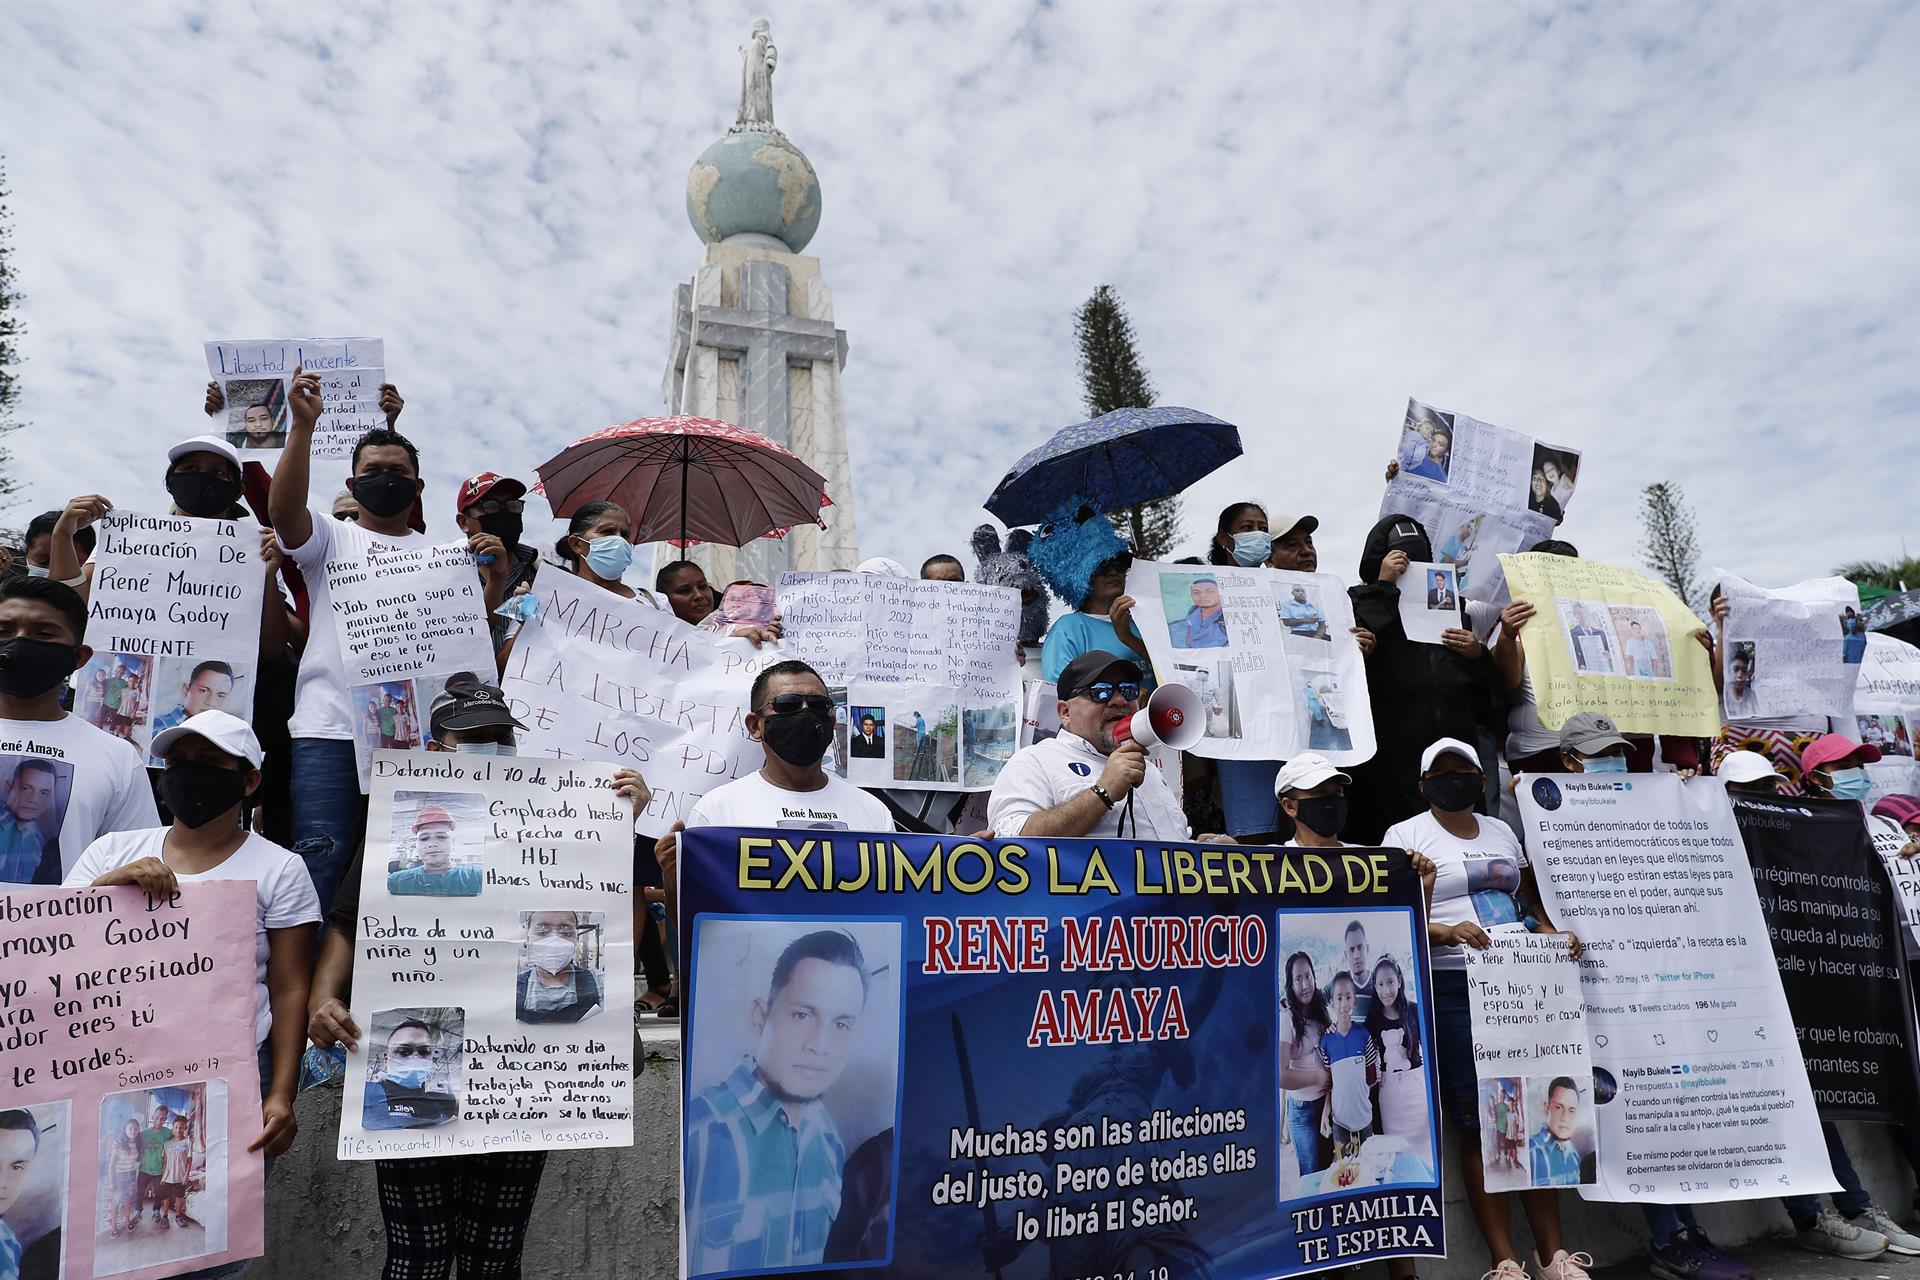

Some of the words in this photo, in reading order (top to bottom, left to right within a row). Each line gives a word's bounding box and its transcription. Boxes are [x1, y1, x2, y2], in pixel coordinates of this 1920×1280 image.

[218, 346, 284, 376] Libertad
[102, 509, 192, 533] Suplicamos
[217, 522, 235, 537] La
[105, 535, 197, 560] Liberación
[220, 545, 247, 564] De
[326, 562, 358, 575] Rene
[367, 552, 423, 567] Mauricio
[100, 567, 152, 592] René
[167, 570, 242, 599] Mauricio
[780, 573, 828, 586] Libertad
[833, 576, 858, 591] para
[887, 581, 939, 594] capturado
[377, 593, 416, 608] nunca
[425, 588, 454, 601] supo
[463, 585, 473, 596] el
[90, 601, 156, 624] Amaya
[169, 602, 229, 630] Godoy
[346, 614, 388, 630] motivo
[395, 608, 408, 620] de
[417, 608, 431, 617] su
[782, 606, 822, 624] Antonio
[825, 610, 863, 623] Navidad
[888, 611, 913, 624] 2022
[962, 616, 991, 632] propia
[350, 642, 368, 654] que
[374, 635, 399, 646] Dios
[406, 633, 416, 641] lo
[422, 627, 459, 639] amaba
[540, 590, 691, 671] MARCHA
[866, 624, 888, 640] hijo
[894, 630, 905, 638] es
[908, 632, 928, 640] una
[110, 637, 194, 656] INOCENTE
[509, 647, 565, 692] LA
[948, 655, 963, 667] No
[971, 660, 993, 669] mas
[949, 671, 995, 685] Regimen
[26, 741, 64, 758] Amaya
[586, 722, 650, 761] LOS
[1566, 783, 1586, 791] Nayib
[1588, 783, 1612, 791] Bukele
[588, 802, 623, 821] hasta
[1570, 798, 1616, 806] @nayibbukele
[782, 808, 805, 819] René
[808, 809, 838, 820] Amaya
[1540, 821, 1550, 832] El
[1553, 820, 1585, 831] común
[1588, 820, 1650, 831] denominador
[1654, 820, 1665, 830] de
[1668, 820, 1692, 830] todos
[1694, 820, 1708, 830] los
[738, 837, 1030, 893] EXIJIMOS
[1047, 847, 1119, 894] LA
[1135, 849, 1333, 894] LIBERTAD
[1342, 855, 1389, 893] DE
[540, 870, 593, 891] brands
[1766, 866, 1818, 886] régimen
[1821, 875, 1870, 891] controla
[1556, 888, 1611, 900] mantenerse
[1614, 889, 1625, 898] en
[1628, 887, 1637, 898] el
[1640, 887, 1670, 900] poder,
[1674, 887, 1705, 899] aunque
[1707, 887, 1722, 896] sus
[1801, 901, 1858, 919] manipula
[460, 926, 494, 939] una
[1781, 927, 1822, 945] queda
[1827, 929, 1837, 944] al
[1840, 932, 1883, 950] pueblo?
[922, 917, 1049, 975] RENE
[1061, 914, 1267, 972] MAURICIO
[424, 946, 436, 965] y
[454, 948, 480, 959] un
[49, 974, 61, 997] y
[76, 953, 213, 990] necesitado
[1654, 973, 1680, 983] Twitter
[1682, 973, 1692, 981] for
[1693, 971, 1715, 980] iPhone
[1508, 978, 1534, 997] hijos
[1541, 986, 1547, 998] y
[1554, 984, 1564, 995] tu
[54, 1000, 82, 1017] en
[93, 991, 121, 1009] mi
[1483, 1000, 1524, 1013] esposa
[1535, 999, 1544, 1010] te
[1638, 1003, 1662, 1012] Tweets
[1663, 1002, 1690, 1012] citados
[1695, 1000, 1708, 1009] 196
[69, 1015, 115, 1038] eres
[131, 1004, 154, 1027] tú
[1027, 986, 1189, 1046] AMAYA
[1486, 1011, 1539, 1026] esperamos
[1546, 1013, 1556, 1022] en
[1474, 1043, 1501, 1062] Porque
[1508, 1046, 1528, 1058] eres
[1534, 1043, 1582, 1058] INOCENTE
[12, 1067, 35, 1088] te
[119, 1068, 174, 1087] Salmos
[950, 1124, 1048, 1159] Muchas
[1053, 1123, 1095, 1150] son
[1102, 1117, 1133, 1146] las
[1138, 1107, 1246, 1143] aflicciones
[932, 1172, 973, 1205] del
[978, 1170, 1049, 1208] justo,
[1056, 1164, 1110, 1193] Pero
[1116, 1157, 1144, 1187] de
[1150, 1150, 1208, 1182] todas
[1212, 1144, 1257, 1175] ellas
[1627, 1163, 1675, 1176] gobernantes
[1677, 1164, 1686, 1172] se
[1688, 1161, 1723, 1171] olvidaron
[1724, 1160, 1733, 1168] de
[1734, 1159, 1740, 1167] la
[1742, 1157, 1784, 1167] democracia.
[1645, 1184, 1655, 1193] 30
[1695, 1182, 1708, 1190] 310
[1744, 1178, 1758, 1187] 554
[1016, 1211, 1039, 1241] lo
[1046, 1203, 1099, 1238] librá
[1106, 1200, 1125, 1232] El
[1131, 1195, 1198, 1229] Señor.
[1292, 1208, 1322, 1234] TU
[1331, 1195, 1439, 1227] FAMILIA
[1299, 1238, 1329, 1263] TE
[1336, 1225, 1434, 1257] ESPERA
